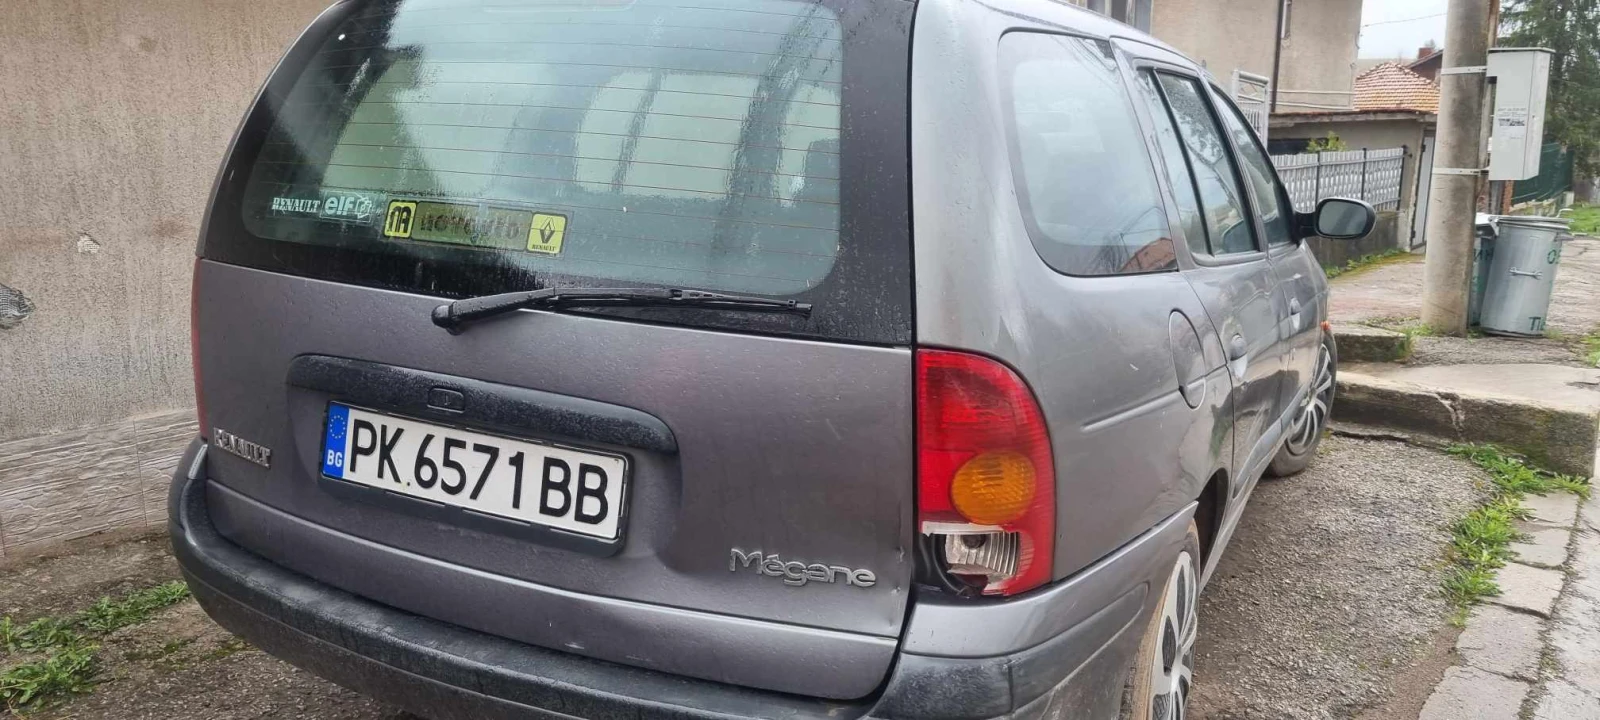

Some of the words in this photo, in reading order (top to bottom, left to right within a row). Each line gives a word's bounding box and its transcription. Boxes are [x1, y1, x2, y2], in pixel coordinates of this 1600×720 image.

[271, 197, 320, 213] RENAULT
[324, 196, 355, 215] elf
[327, 449, 343, 468] BG
[729, 548, 877, 587] Mégane
